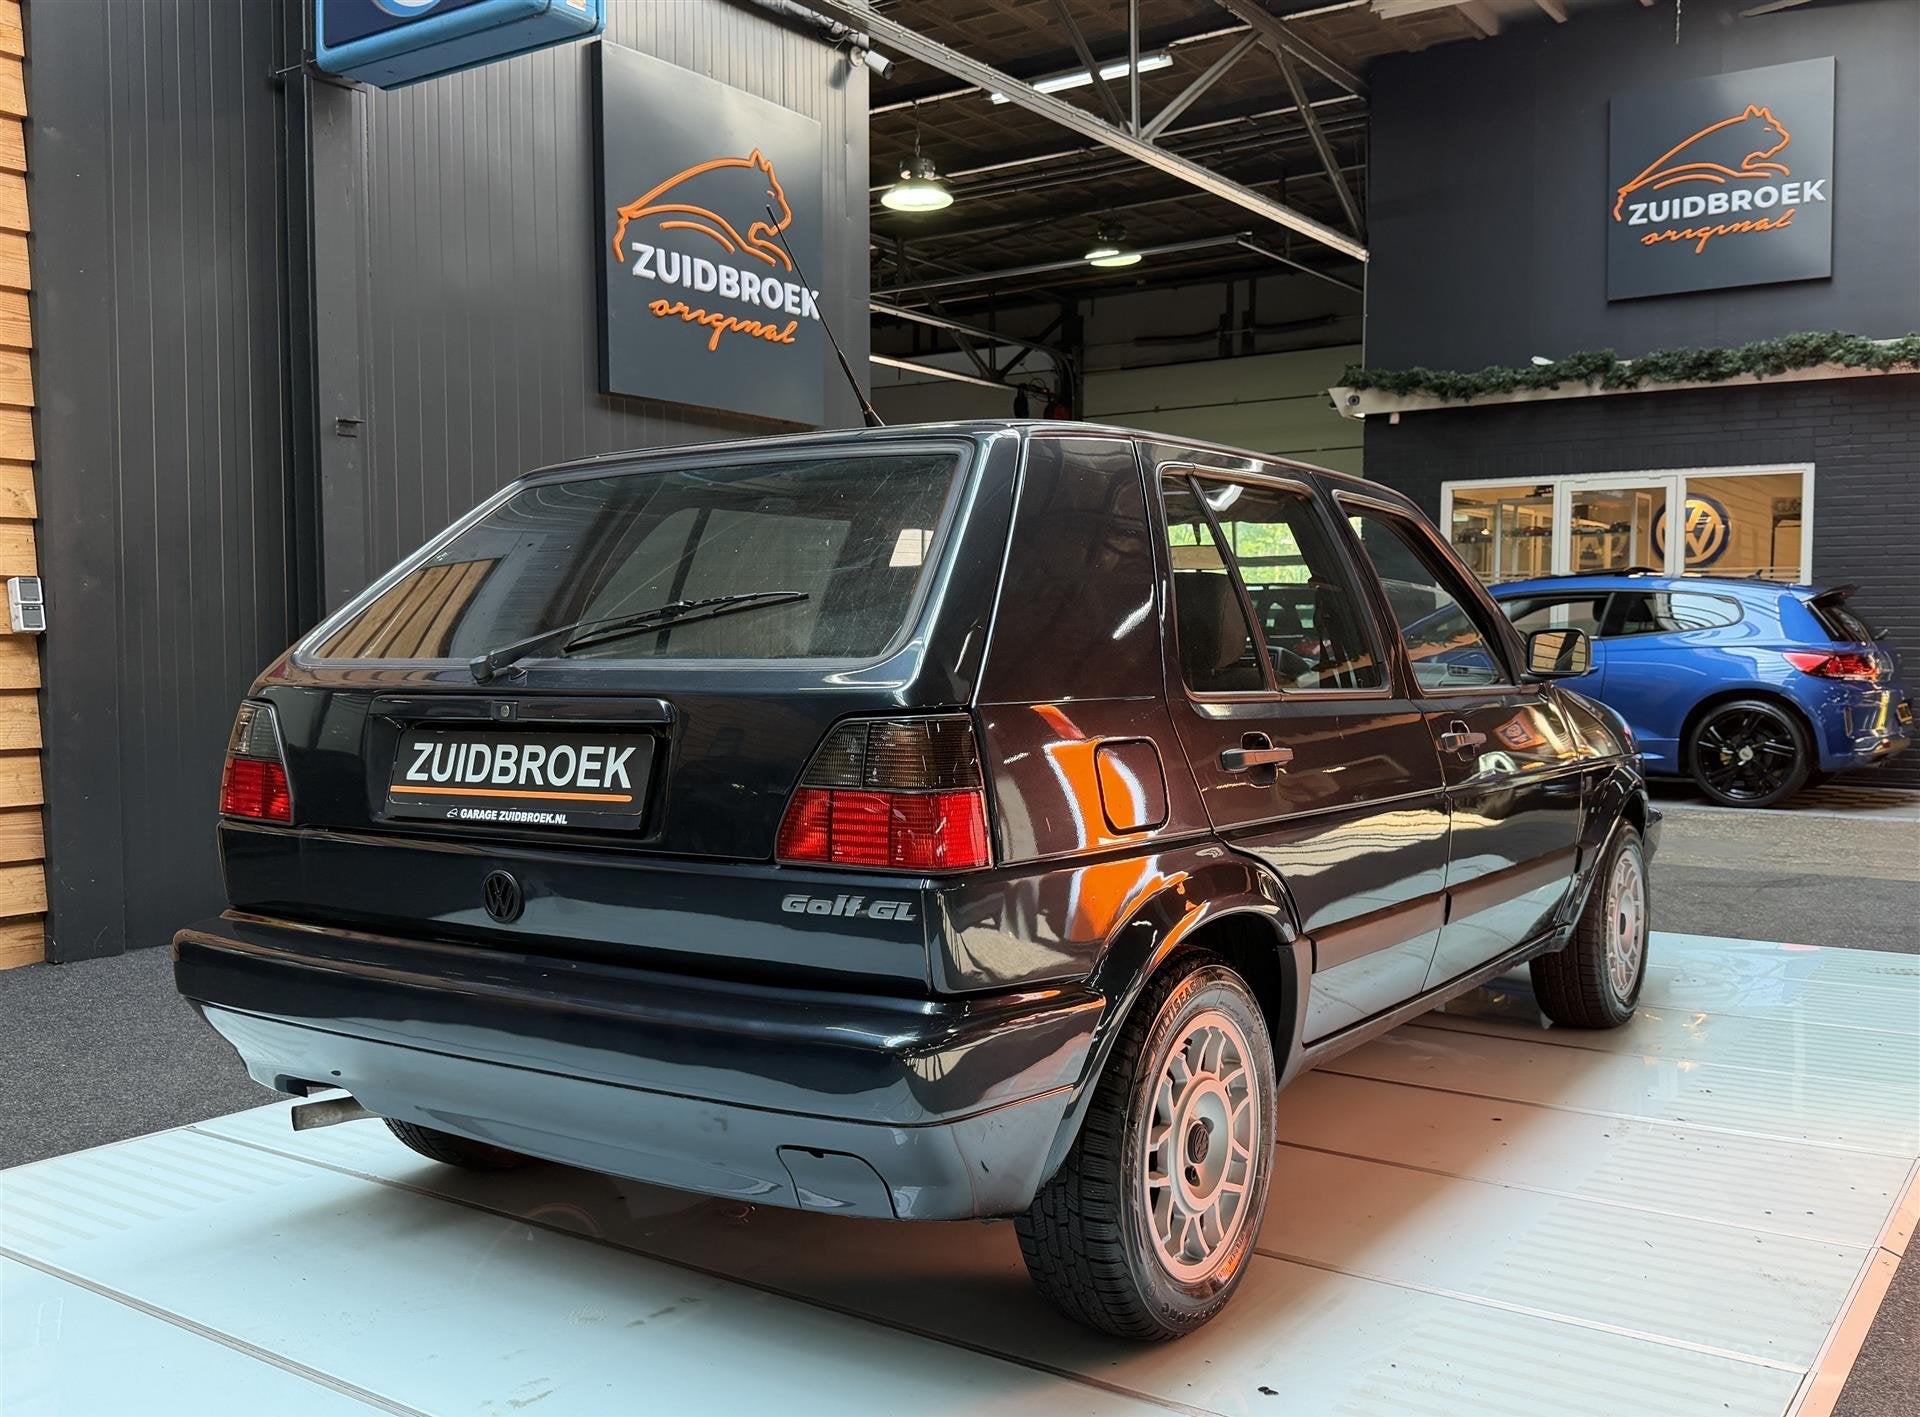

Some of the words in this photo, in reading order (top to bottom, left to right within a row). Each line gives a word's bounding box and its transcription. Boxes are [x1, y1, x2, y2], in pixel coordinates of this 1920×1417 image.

[1628, 179, 1826, 226] ZUIDBROEK
[1640, 208, 1796, 255] original
[631, 242, 820, 321] ZUIDBROEK
[648, 299, 798, 352] original
[406, 742, 637, 789] ZUIDBROEK
[460, 808, 498, 820] GARAGE
[498, 810, 568, 825] ZUIDBROEK.NL
[782, 894, 866, 917] Golf
[868, 900, 916, 921] GL
